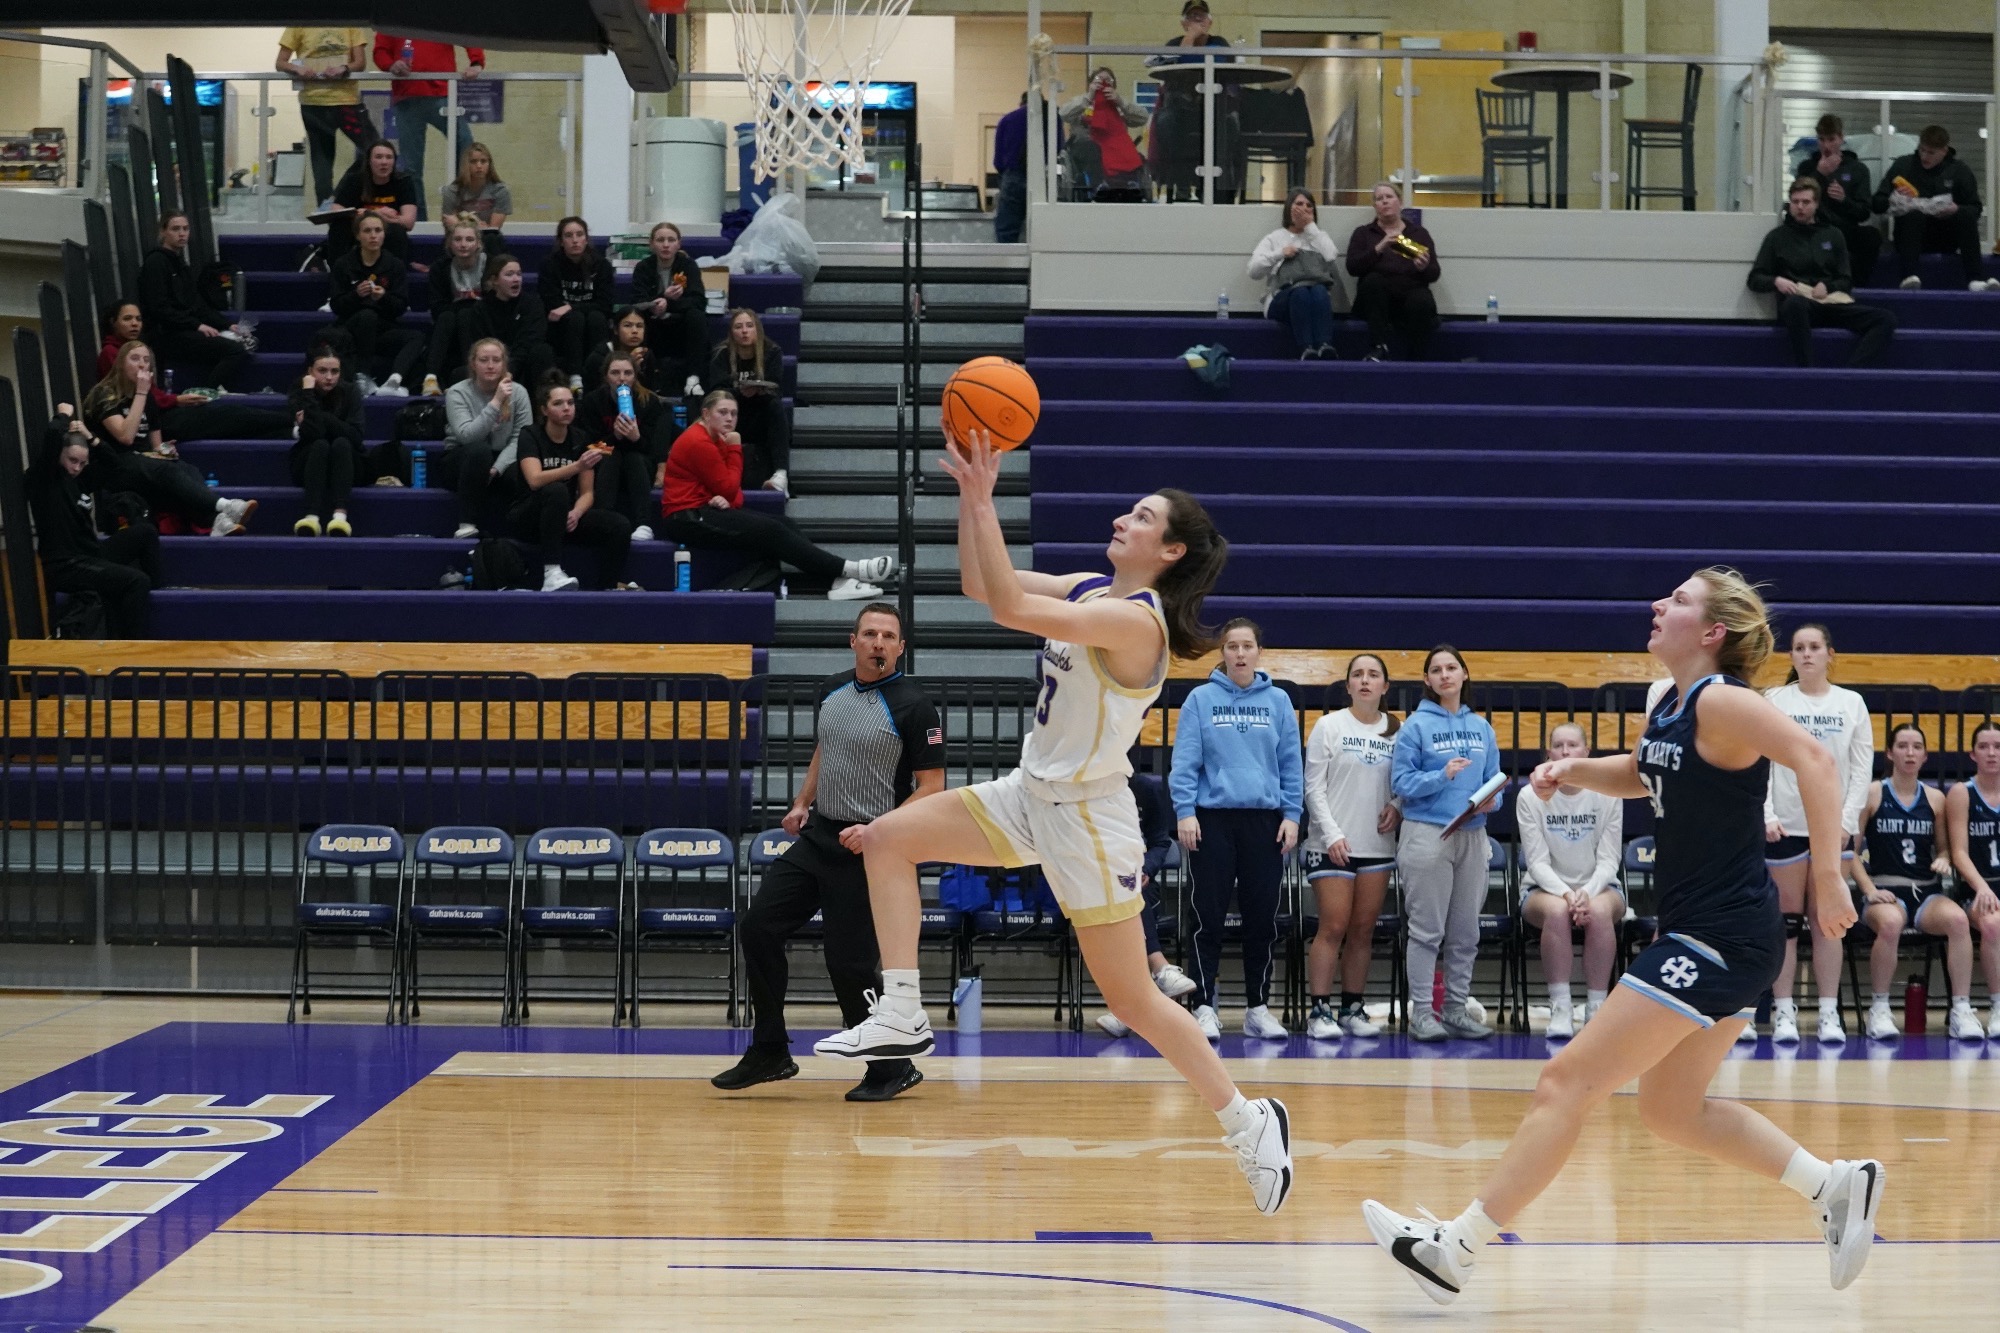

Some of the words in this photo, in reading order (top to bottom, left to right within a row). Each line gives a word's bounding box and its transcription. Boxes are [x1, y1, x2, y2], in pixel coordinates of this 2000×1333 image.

[1212, 705, 1236, 716] SAINT
[1238, 706, 1270, 717] MARY'S
[1212, 715, 1270, 723] BASKETBALL
[1342, 736, 1366, 747] SAINT
[1546, 815, 1568, 825] SAINT
[1876, 818, 1904, 833] SAINT
[1969, 821, 1995, 837] SAINT
[319, 836, 392, 852] LORAS
[429, 838, 502, 854] LORAS
[538, 838, 611, 855] LORAS
[648, 839, 721, 857] LORAS
[1901, 838, 1916, 865] 2
[315, 907, 370, 918] duhawks.com
[428, 909, 484, 920] duhawks.com
[541, 910, 596, 921] duhawks.com
[662, 912, 717, 923] duhawks.com
